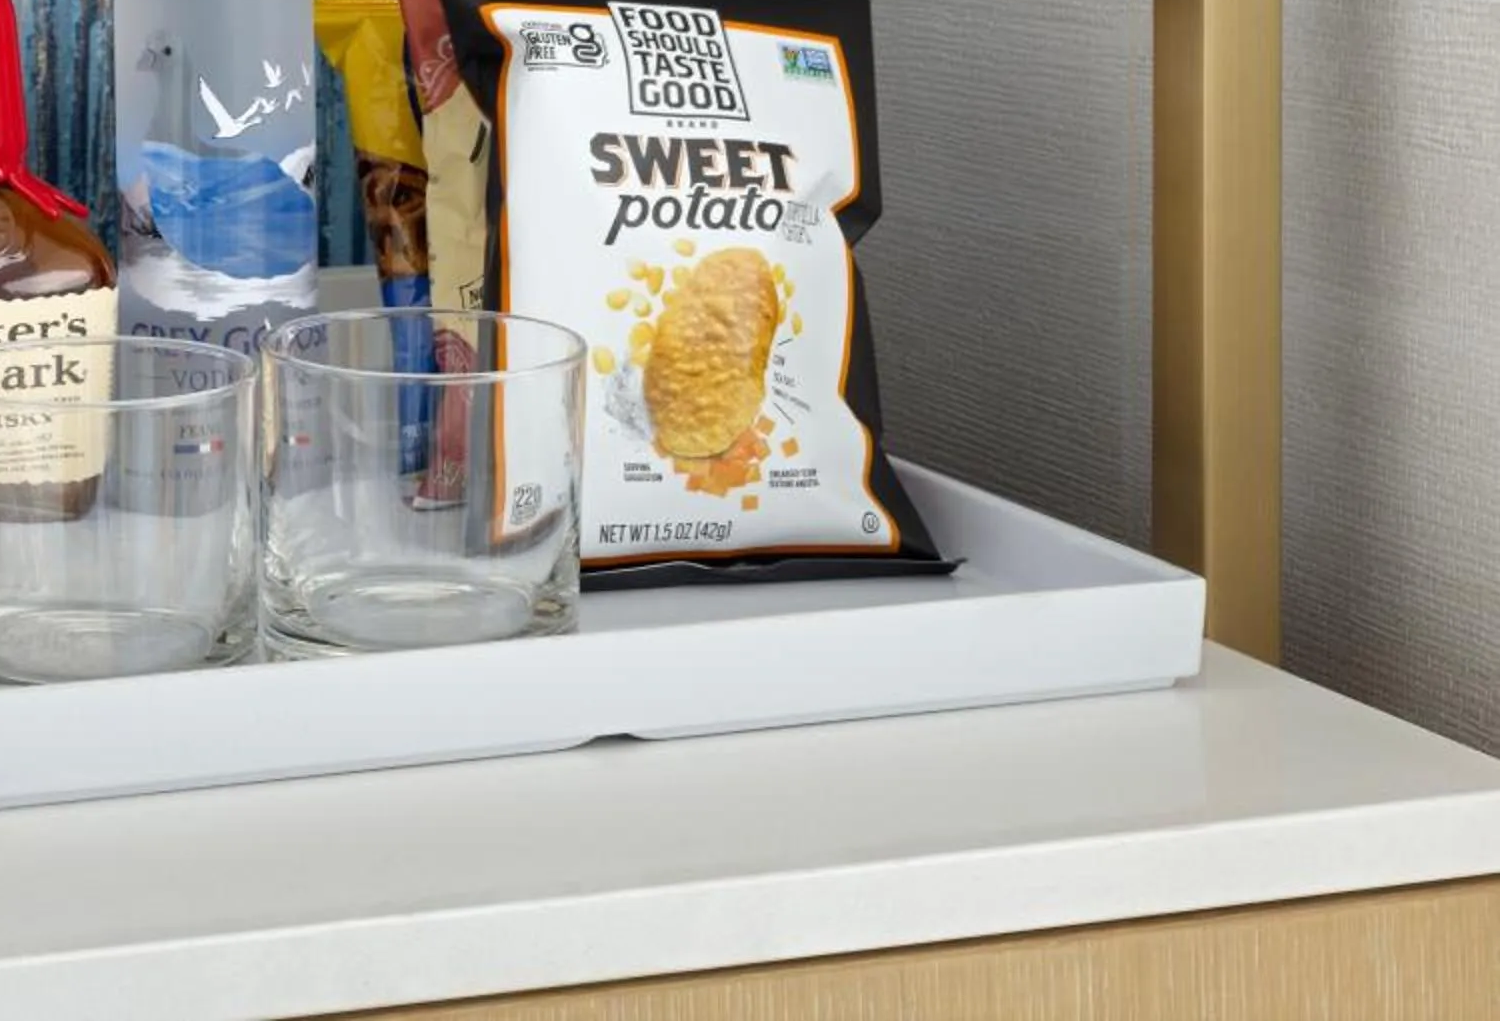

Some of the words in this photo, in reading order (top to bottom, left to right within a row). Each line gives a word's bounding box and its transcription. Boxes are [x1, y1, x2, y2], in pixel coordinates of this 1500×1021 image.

[618, 6, 716, 37] FOOD
[529, 45, 556, 60] FREE
[627, 30, 722, 59] SHOULD
[633, 50, 730, 84] TASTE
[639, 79, 737, 111] GOOD
[590, 132, 794, 192] SWEET
[604, 186, 783, 246] potato
[599, 524, 626, 543] NET
[629, 523, 651, 541] WT
[652, 521, 673, 541] 1.5
[676, 522, 693, 540] OZ
